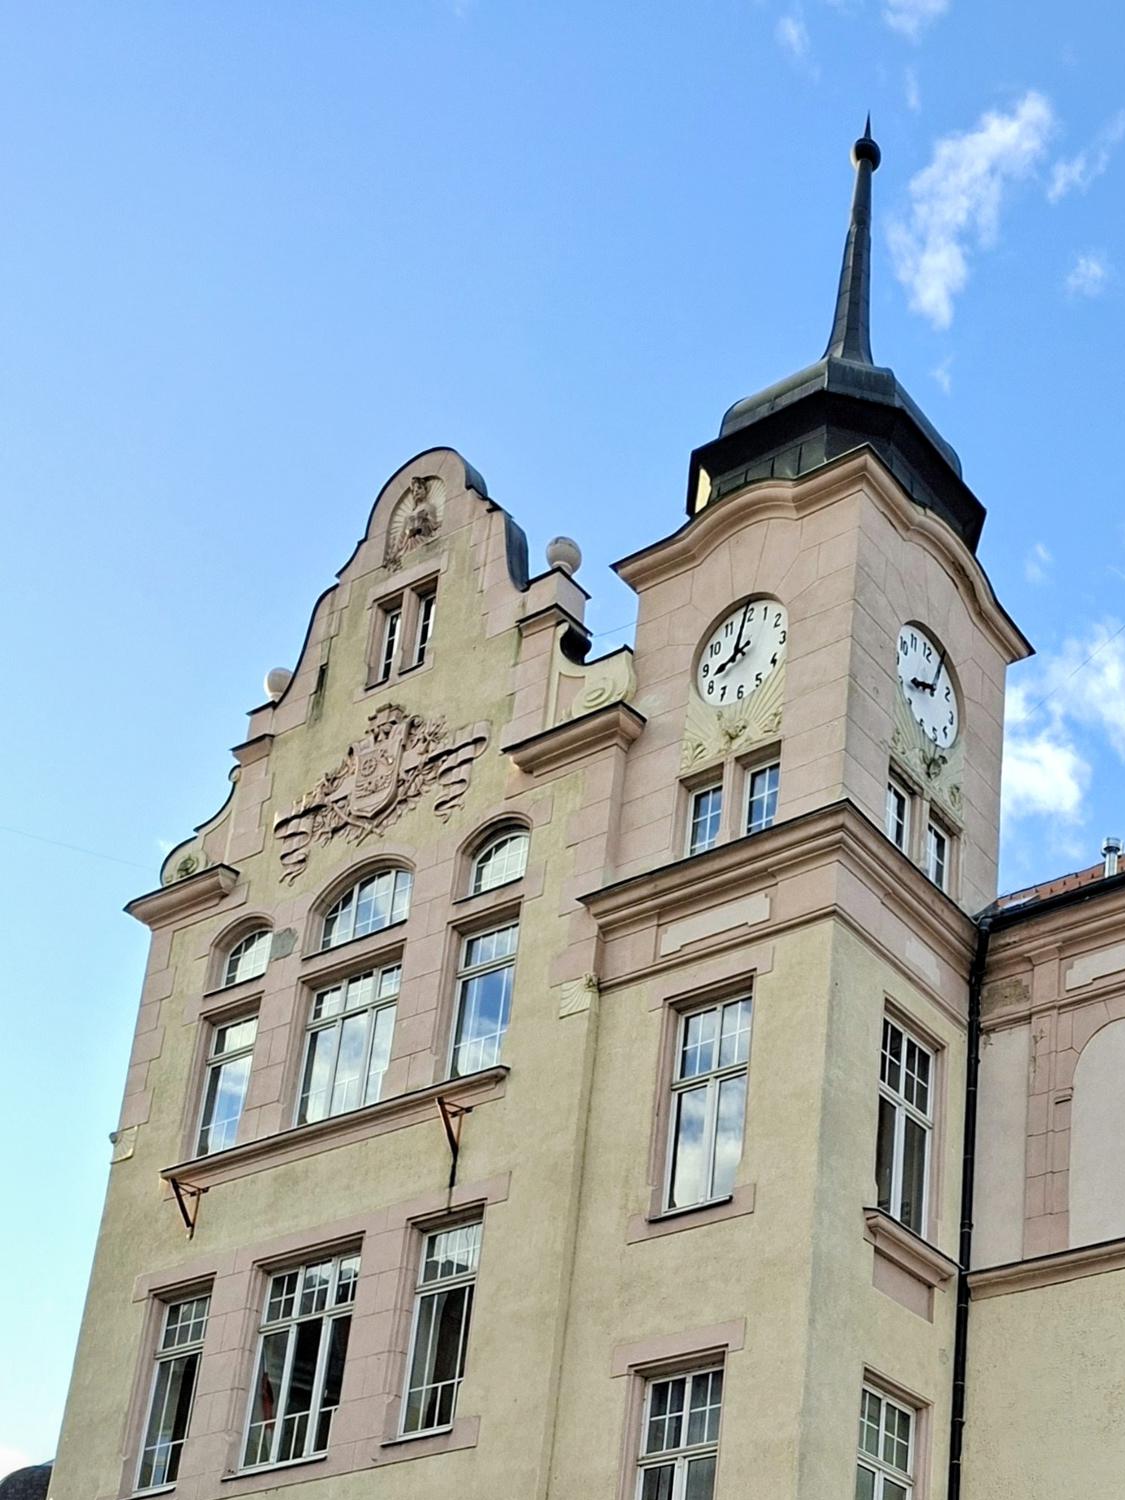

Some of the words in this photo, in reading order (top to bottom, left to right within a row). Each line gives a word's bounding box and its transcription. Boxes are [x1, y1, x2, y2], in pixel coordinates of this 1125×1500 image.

[763, 606, 768, 621] 1
[773, 612, 782, 628] 2
[725, 621, 734, 638] 11
[779, 630, 787, 645] 3
[709, 641, 722, 658] 10
[900, 635, 909, 656] 10
[910, 633, 918, 652] 11
[770, 652, 778, 668] 4
[923, 642, 932, 663] 12
[702, 664, 709, 678] 9
[707, 680, 714, 695] 8
[755, 672, 763, 688] 5
[720, 685, 727, 702] 7
[737, 684, 744, 700] 6
[944, 686, 951, 702] 2
